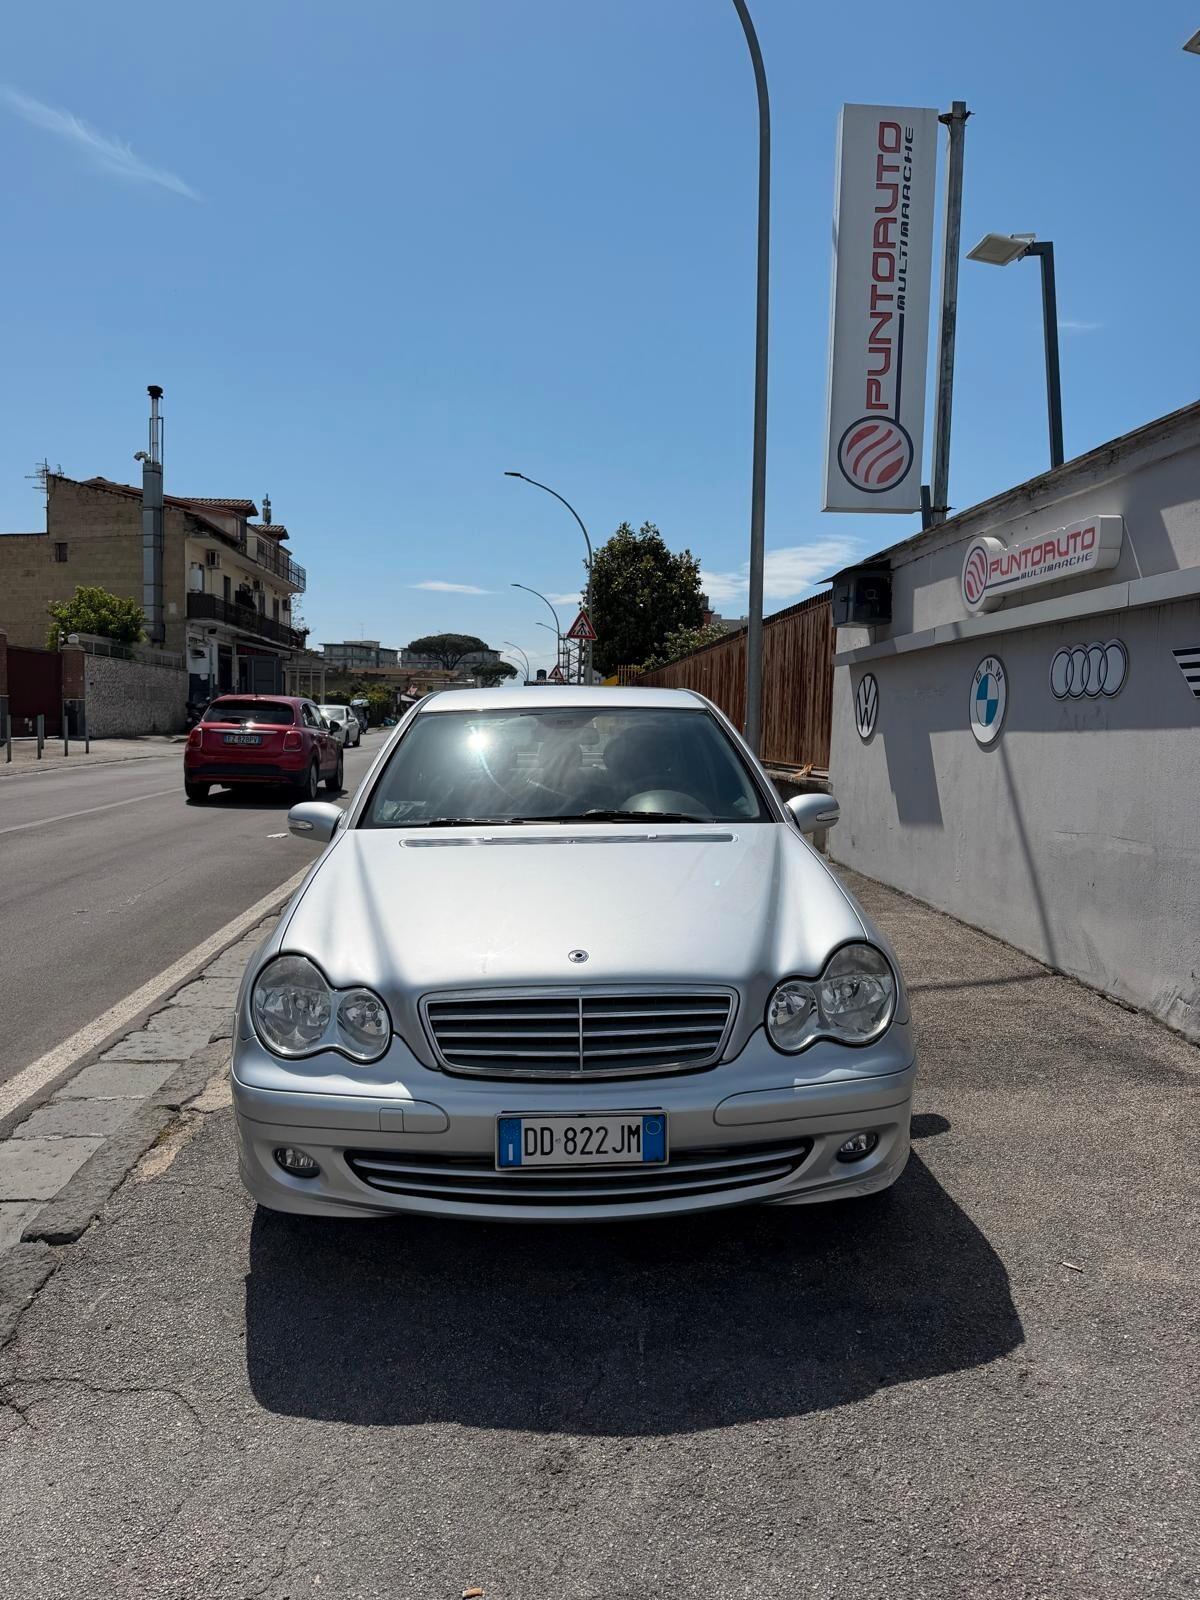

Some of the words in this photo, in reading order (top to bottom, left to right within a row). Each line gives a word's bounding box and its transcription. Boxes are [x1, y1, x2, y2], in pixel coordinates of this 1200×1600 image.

[896, 126, 914, 311] MULTIMARCHE
[865, 120, 902, 410] PUNTOAUTO
[988, 526, 1096, 580] PUNTOAUTO
[1019, 551, 1094, 580] MULTIMARCHE
[975, 660, 1003, 684] BMW
[523, 1126, 554, 1157] DD
[563, 1124, 641, 1156] 822JM
